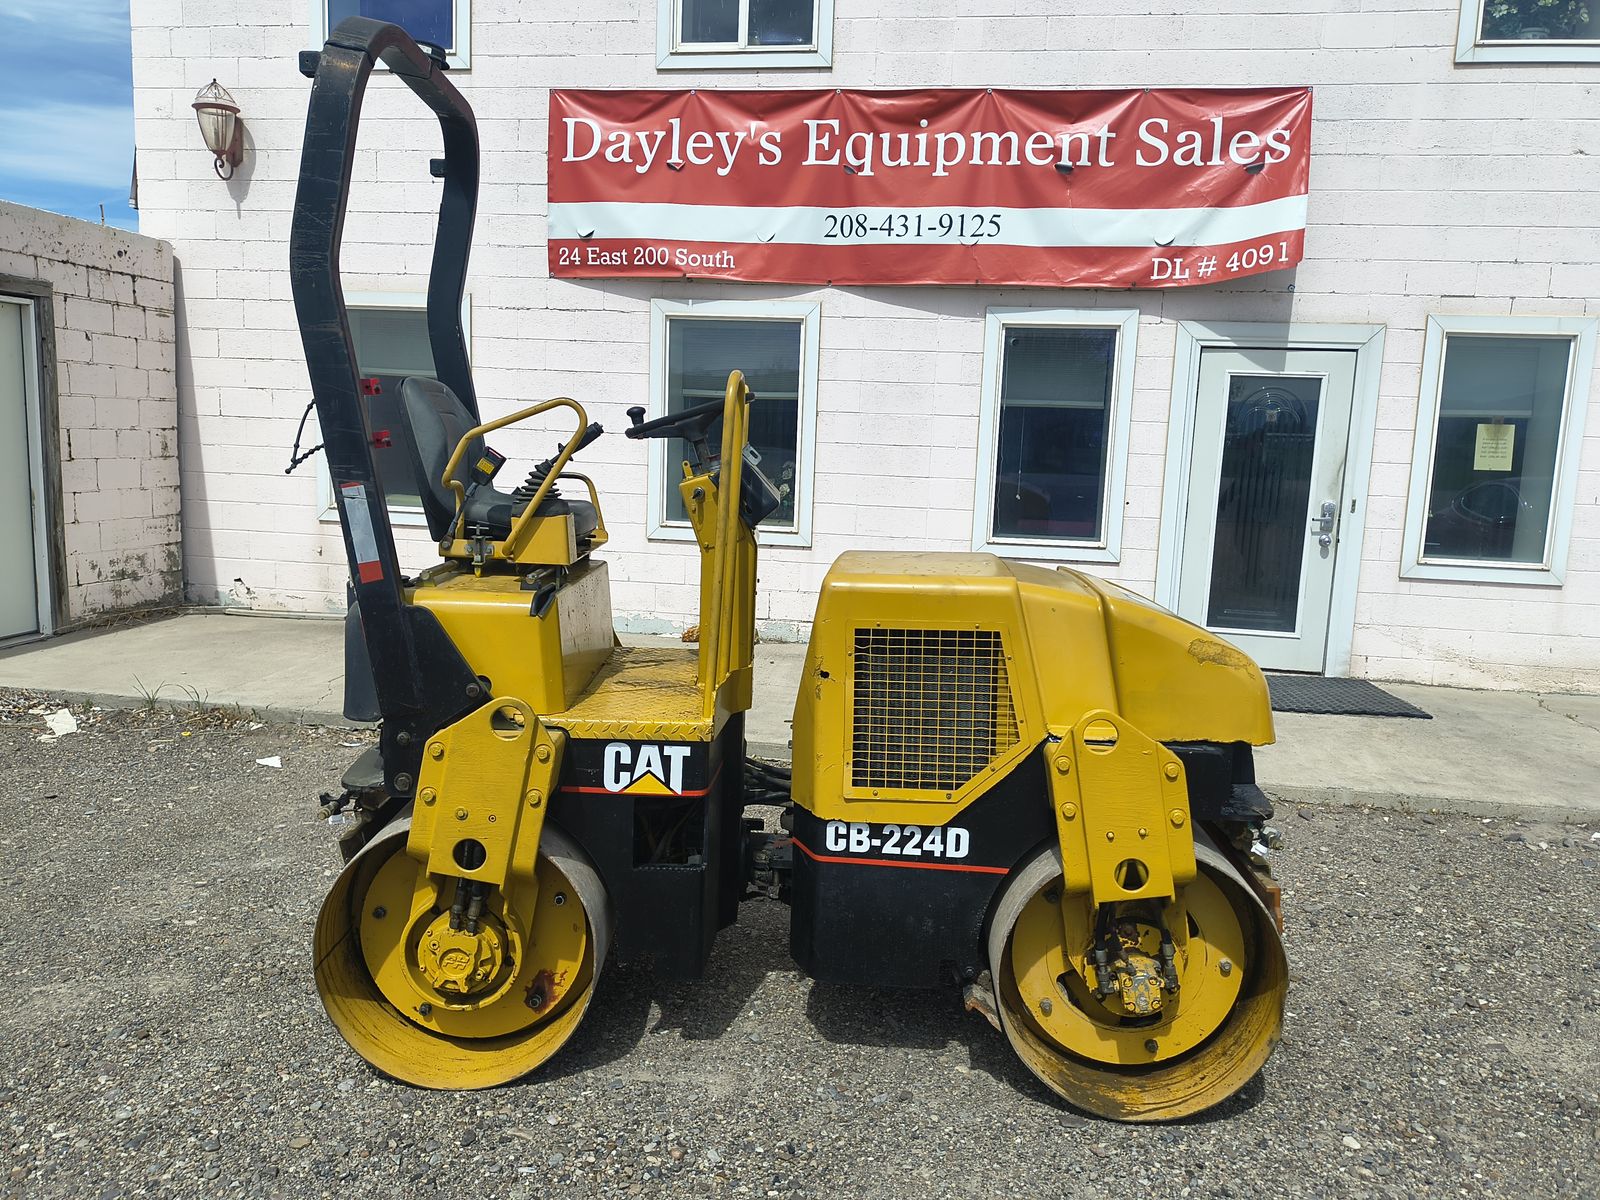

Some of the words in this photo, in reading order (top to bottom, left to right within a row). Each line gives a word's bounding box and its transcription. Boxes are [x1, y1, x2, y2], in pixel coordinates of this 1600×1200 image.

[562, 117, 782, 175] Dayley's
[802, 119, 1115, 176] Equipment
[1136, 117, 1291, 166] Sales
[825, 213, 1001, 239] 208-431-9125
[559, 247, 581, 266] 24
[586, 247, 628, 266] East
[633, 247, 669, 266] 200
[676, 248, 735, 268] South
[1151, 257, 1189, 280] DL
[1198, 257, 1217, 277] #
[1226, 241, 1289, 271] 4091
[603, 742, 691, 795] CAT
[825, 820, 970, 858] CB-224D
